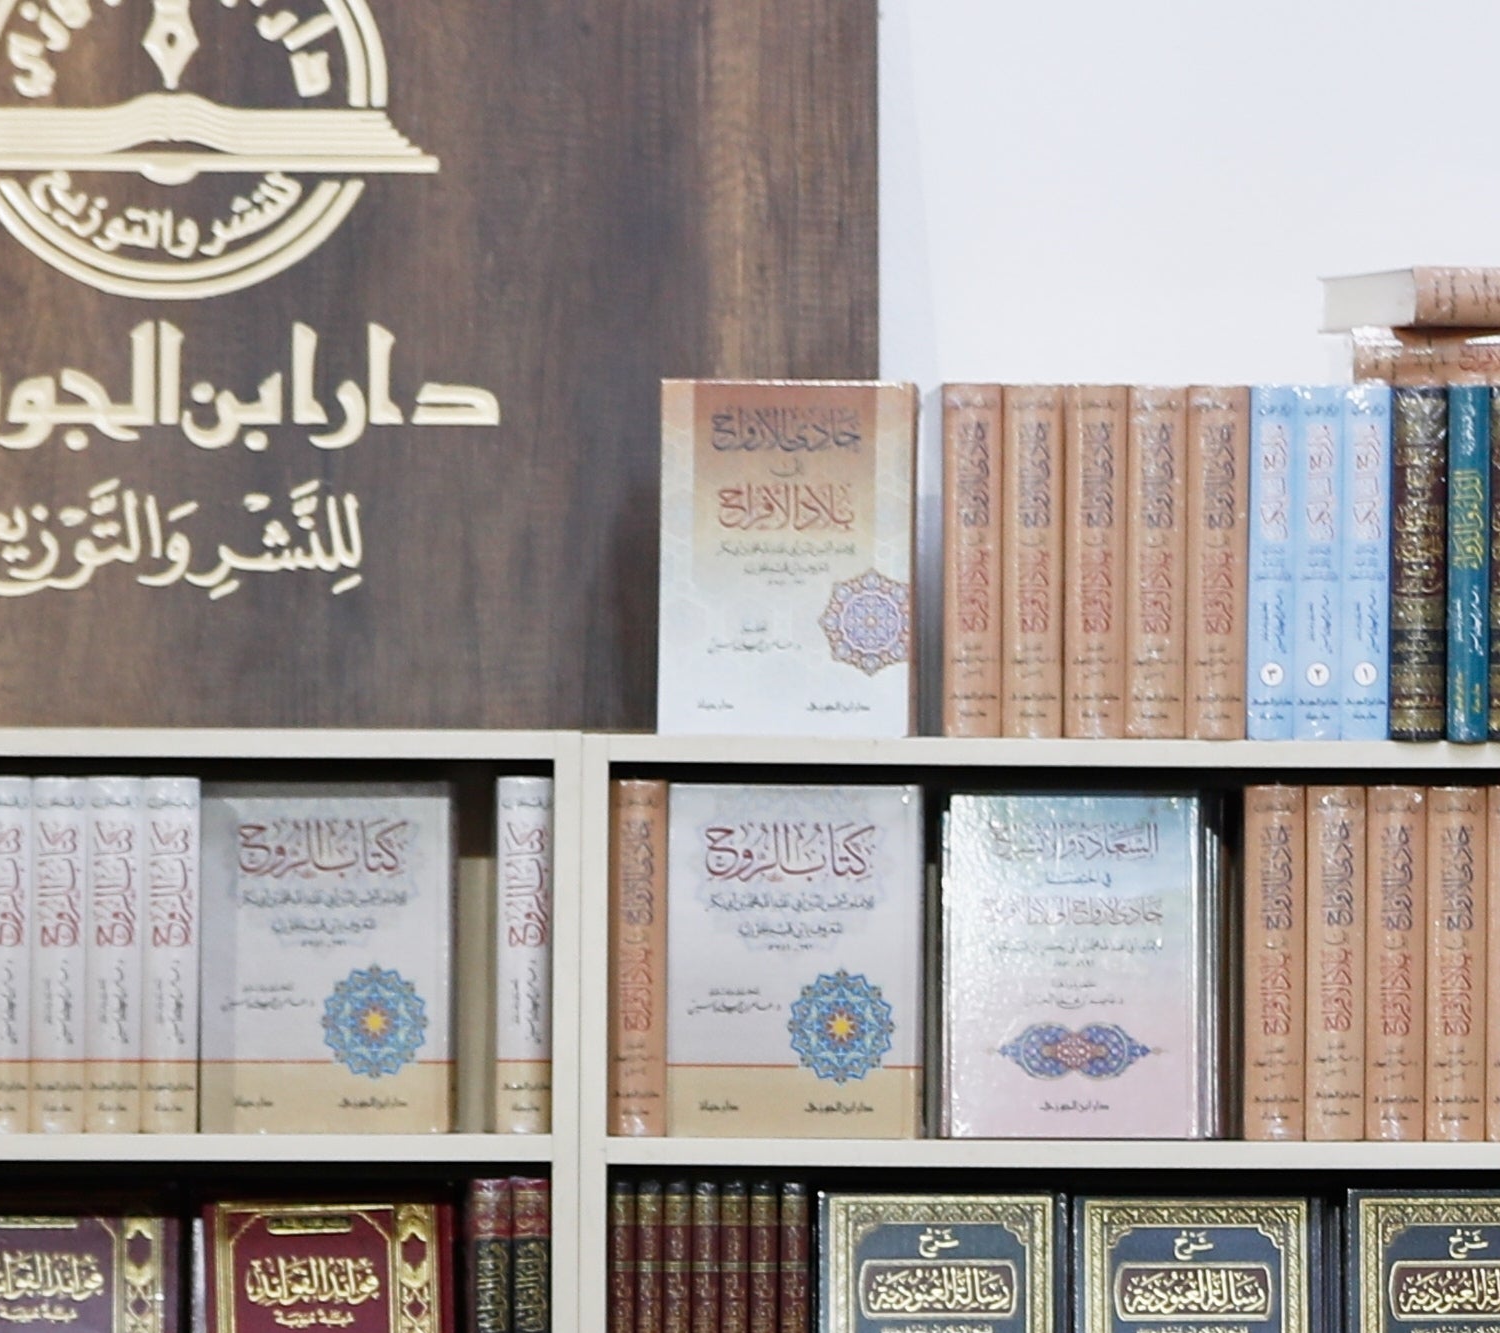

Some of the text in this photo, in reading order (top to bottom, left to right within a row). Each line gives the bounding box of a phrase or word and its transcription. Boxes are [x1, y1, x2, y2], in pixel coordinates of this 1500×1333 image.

[28, 172, 301, 257] للنشر والتوزيع
[182, 321, 327, 450] ابن
[309, 321, 499, 450] دار
